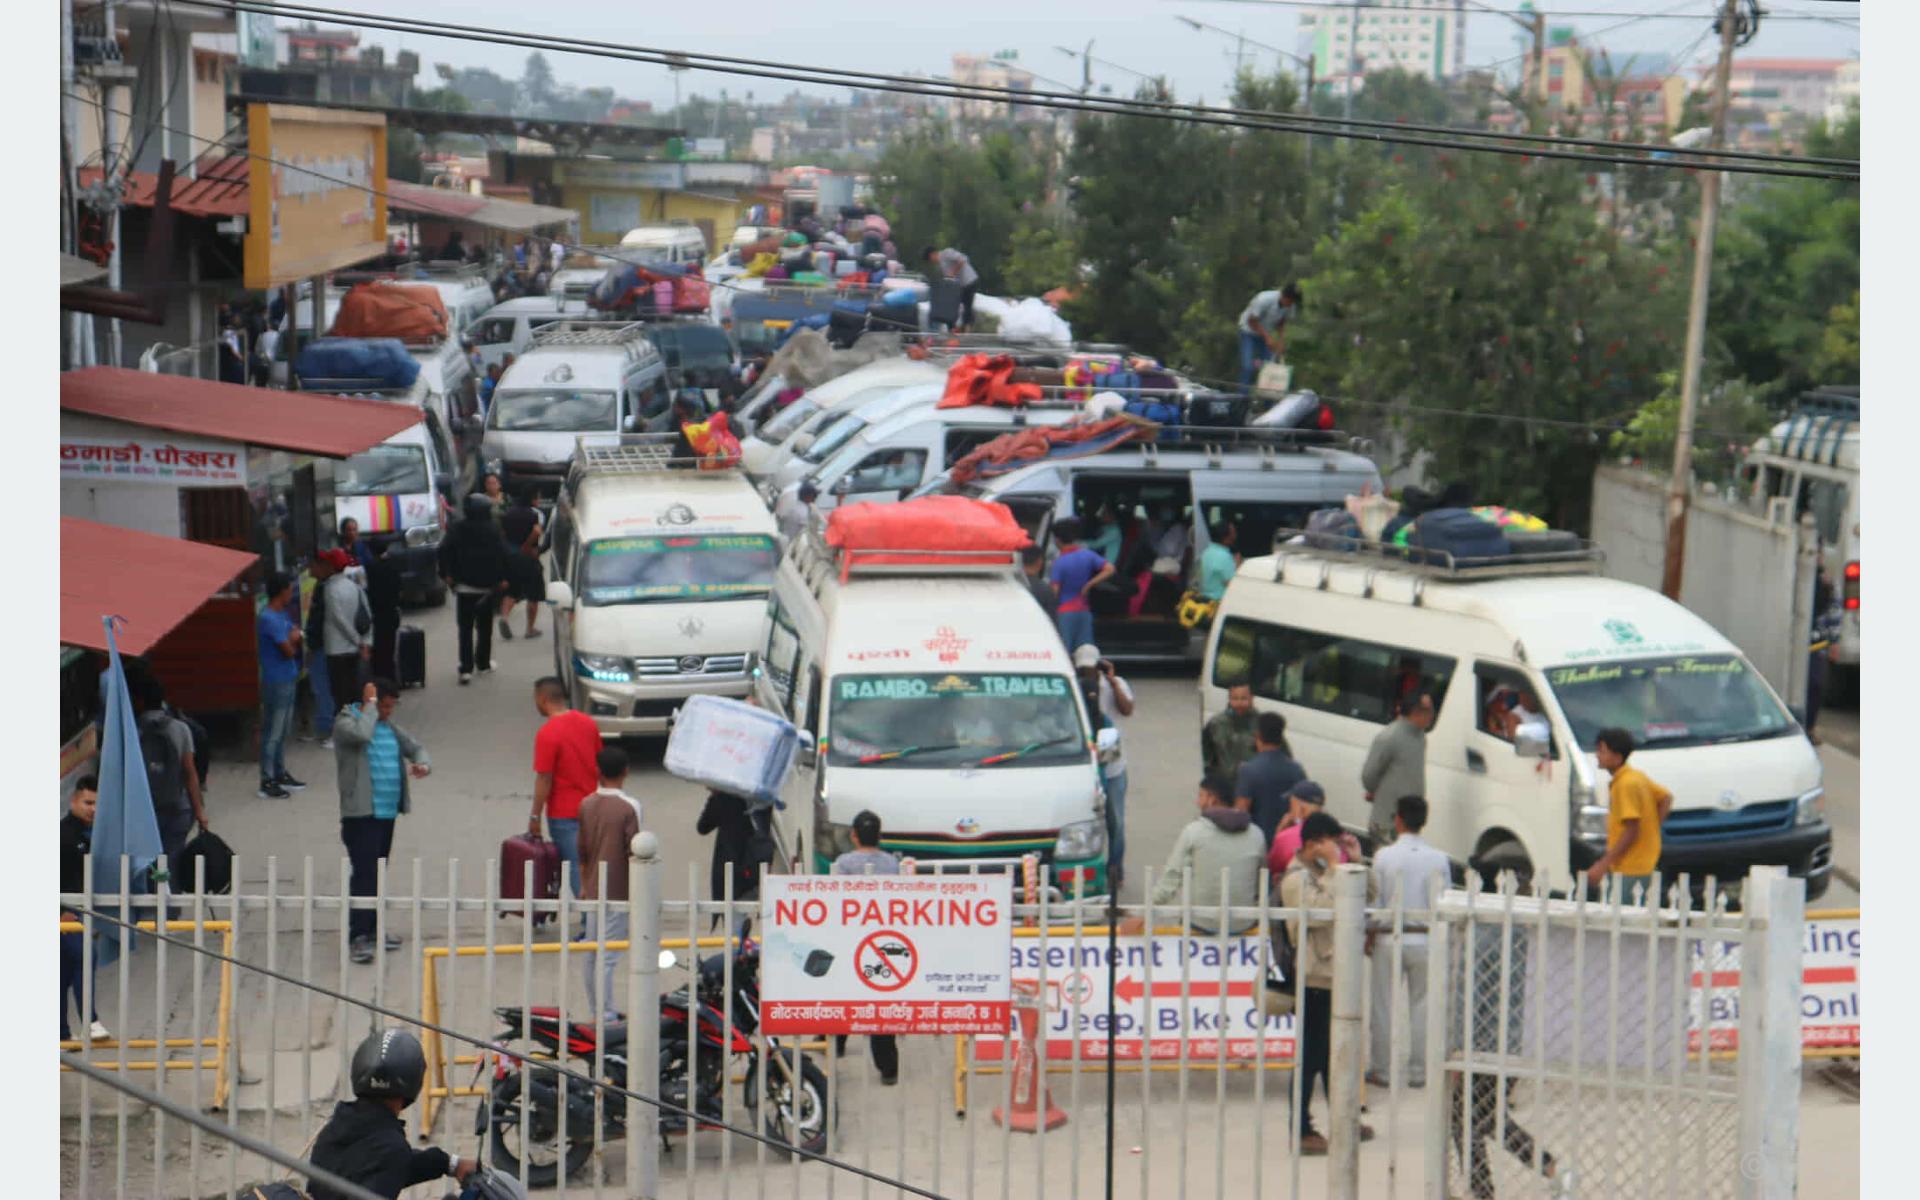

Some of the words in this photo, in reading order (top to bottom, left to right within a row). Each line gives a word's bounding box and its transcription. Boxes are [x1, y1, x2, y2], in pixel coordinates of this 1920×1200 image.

[841, 679, 927, 699] RAMBO
[982, 677, 1066, 696] TRAVELS
[775, 898, 828, 926] NO
[841, 898, 998, 926] PARKING
[1011, 942, 1163, 968] asement
[1801, 992, 1858, 1019] Onl
[1053, 1007, 1144, 1036] Jeep,
[1159, 1007, 1230, 1031] Bke
[1245, 1007, 1292, 1030] On
